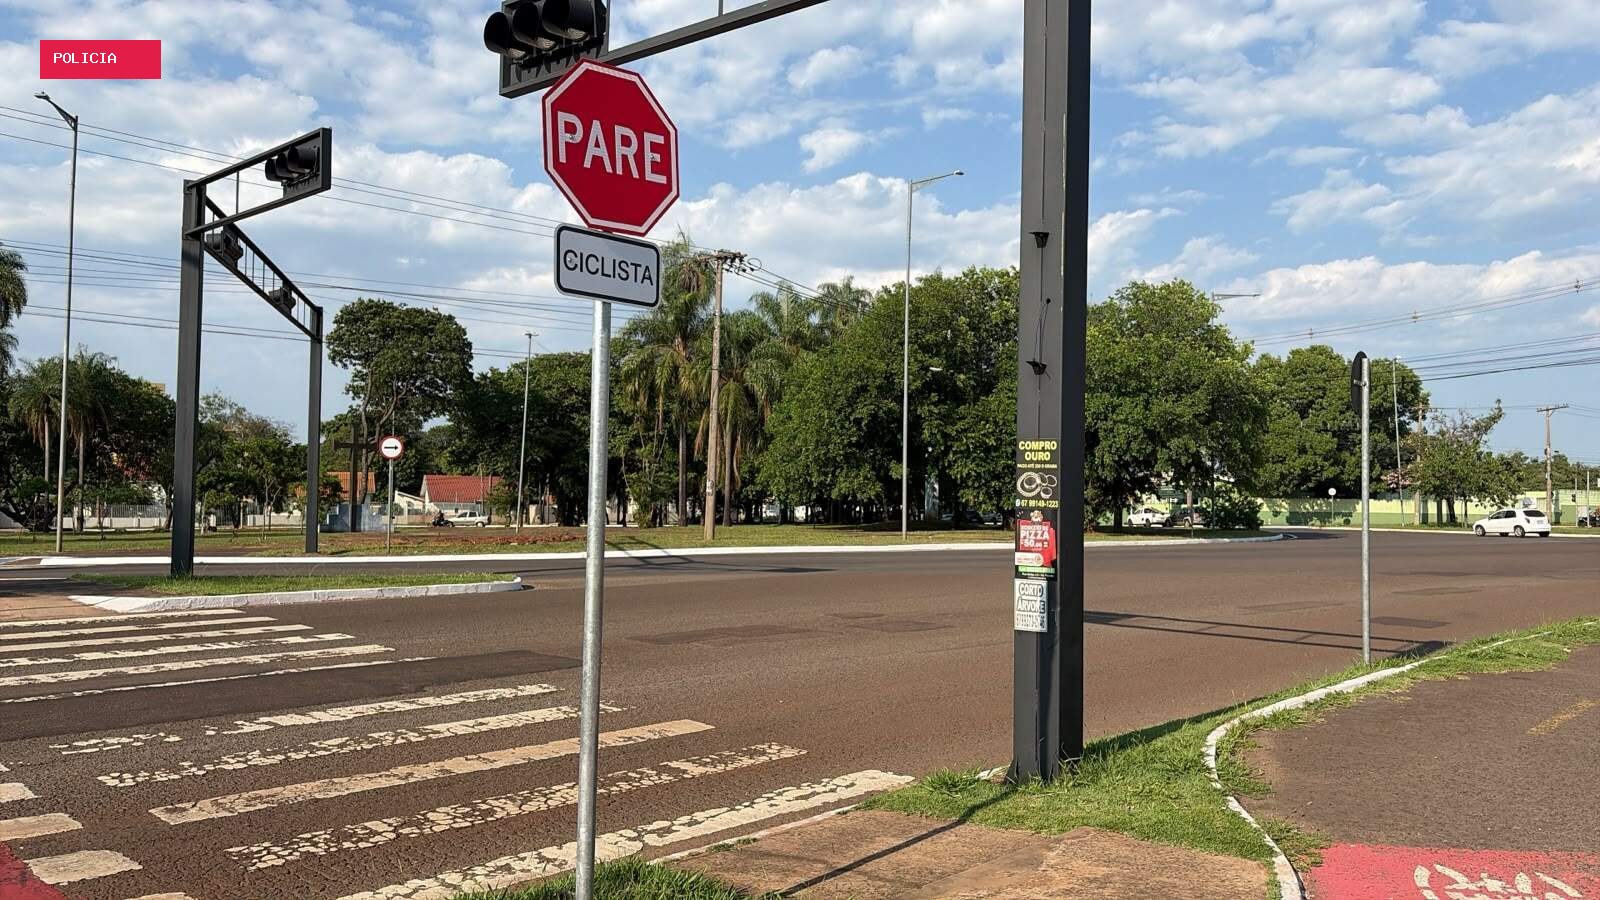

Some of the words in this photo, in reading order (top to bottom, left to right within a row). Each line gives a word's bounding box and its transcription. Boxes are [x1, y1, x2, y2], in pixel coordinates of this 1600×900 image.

[557, 111, 667, 184] PARE
[563, 249, 653, 286] CICLISTA
[1018, 441, 1057, 450] COMPRO
[1024, 451, 1051, 461] OURO
[1020, 530, 1050, 540] PIZZA
[1019, 583, 1043, 597] CORTO
